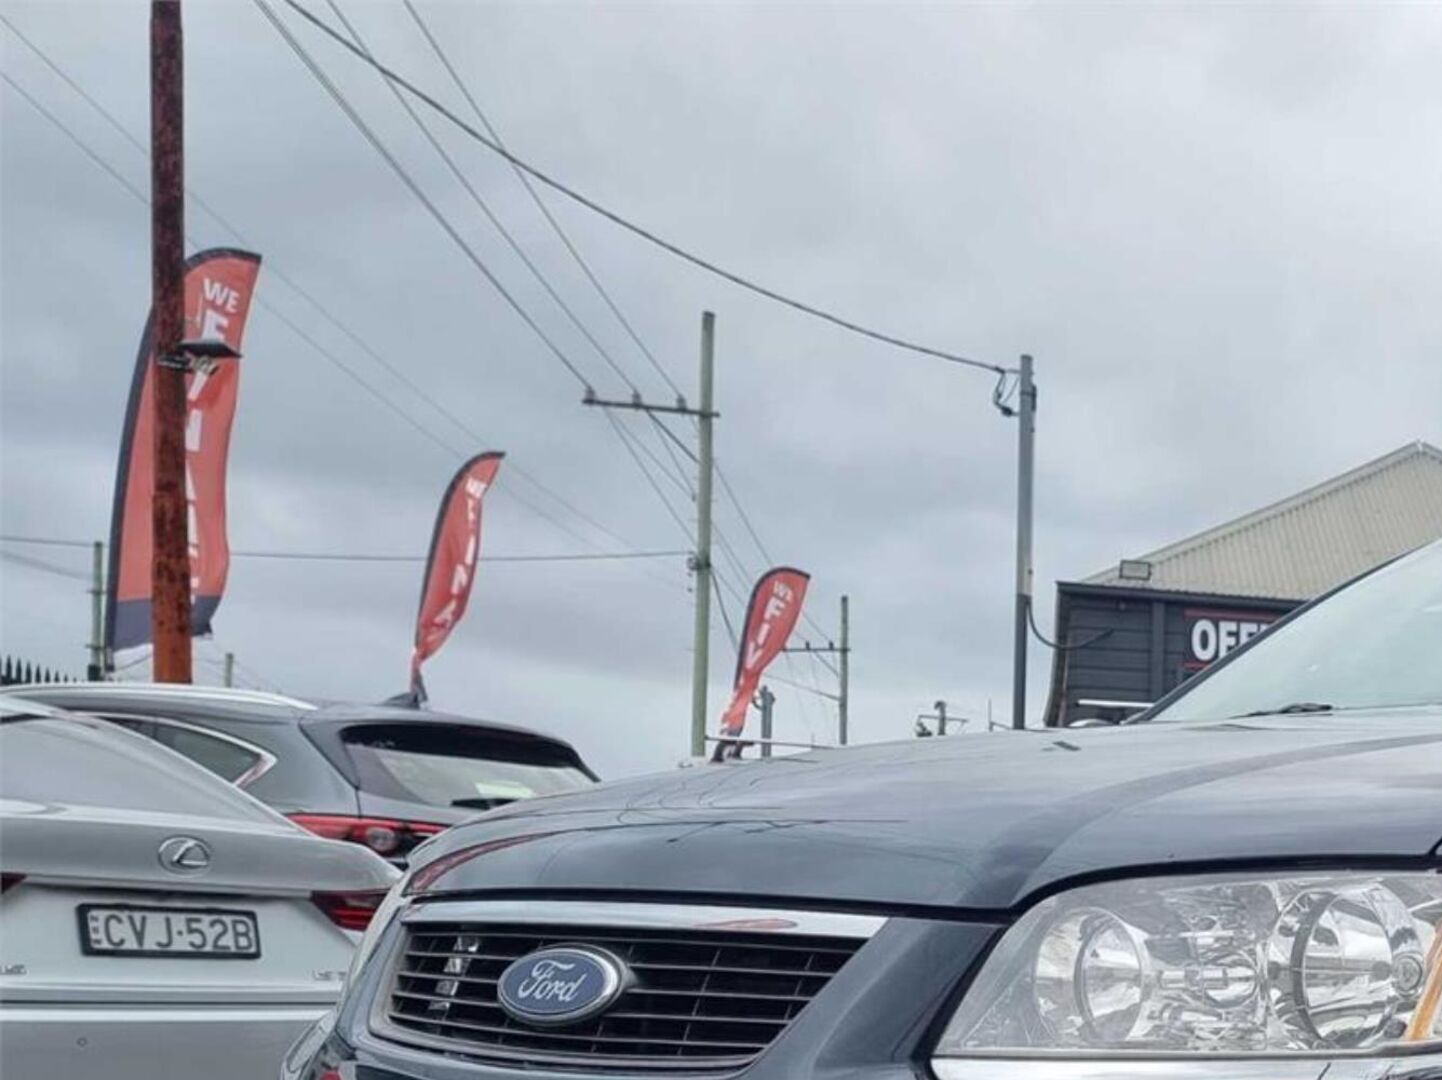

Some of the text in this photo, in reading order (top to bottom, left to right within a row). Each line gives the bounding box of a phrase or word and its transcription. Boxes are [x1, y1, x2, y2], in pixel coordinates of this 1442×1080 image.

[203, 278, 240, 313] WE
[1191, 619, 1270, 661] OFF
[517, 959, 587, 1002] Ford
